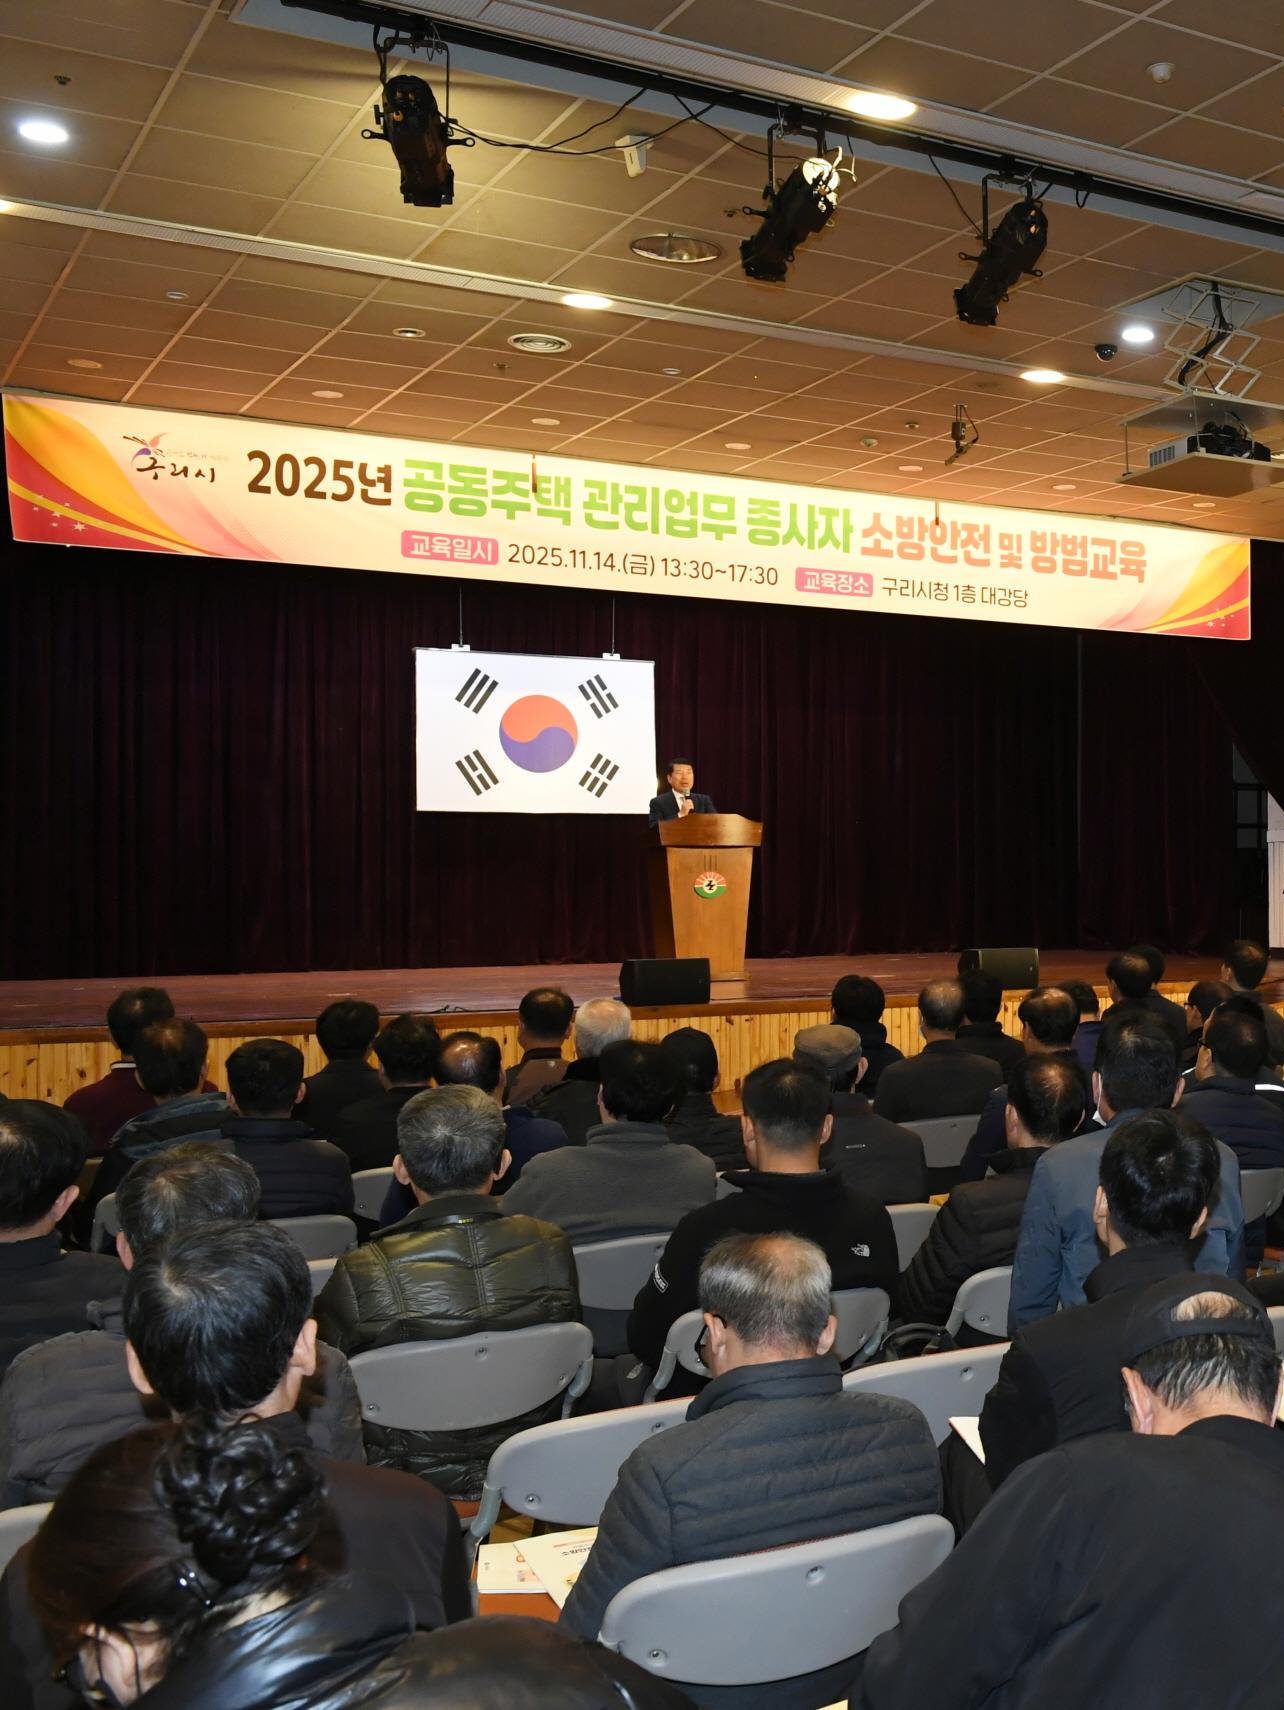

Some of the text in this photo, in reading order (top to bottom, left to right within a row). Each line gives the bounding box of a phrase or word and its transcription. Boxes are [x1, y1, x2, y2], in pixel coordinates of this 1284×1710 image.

[136, 456, 215, 483] 구리시
[246, 449, 1147, 583] 2025년 공동주택 관리업무 종사자 소방안전 및 방범교육
[409, 533, 1029, 608] 교육일시 2025.11.14.(금) 13:30~17:30 교육장소 구리시청 1층 대강당
